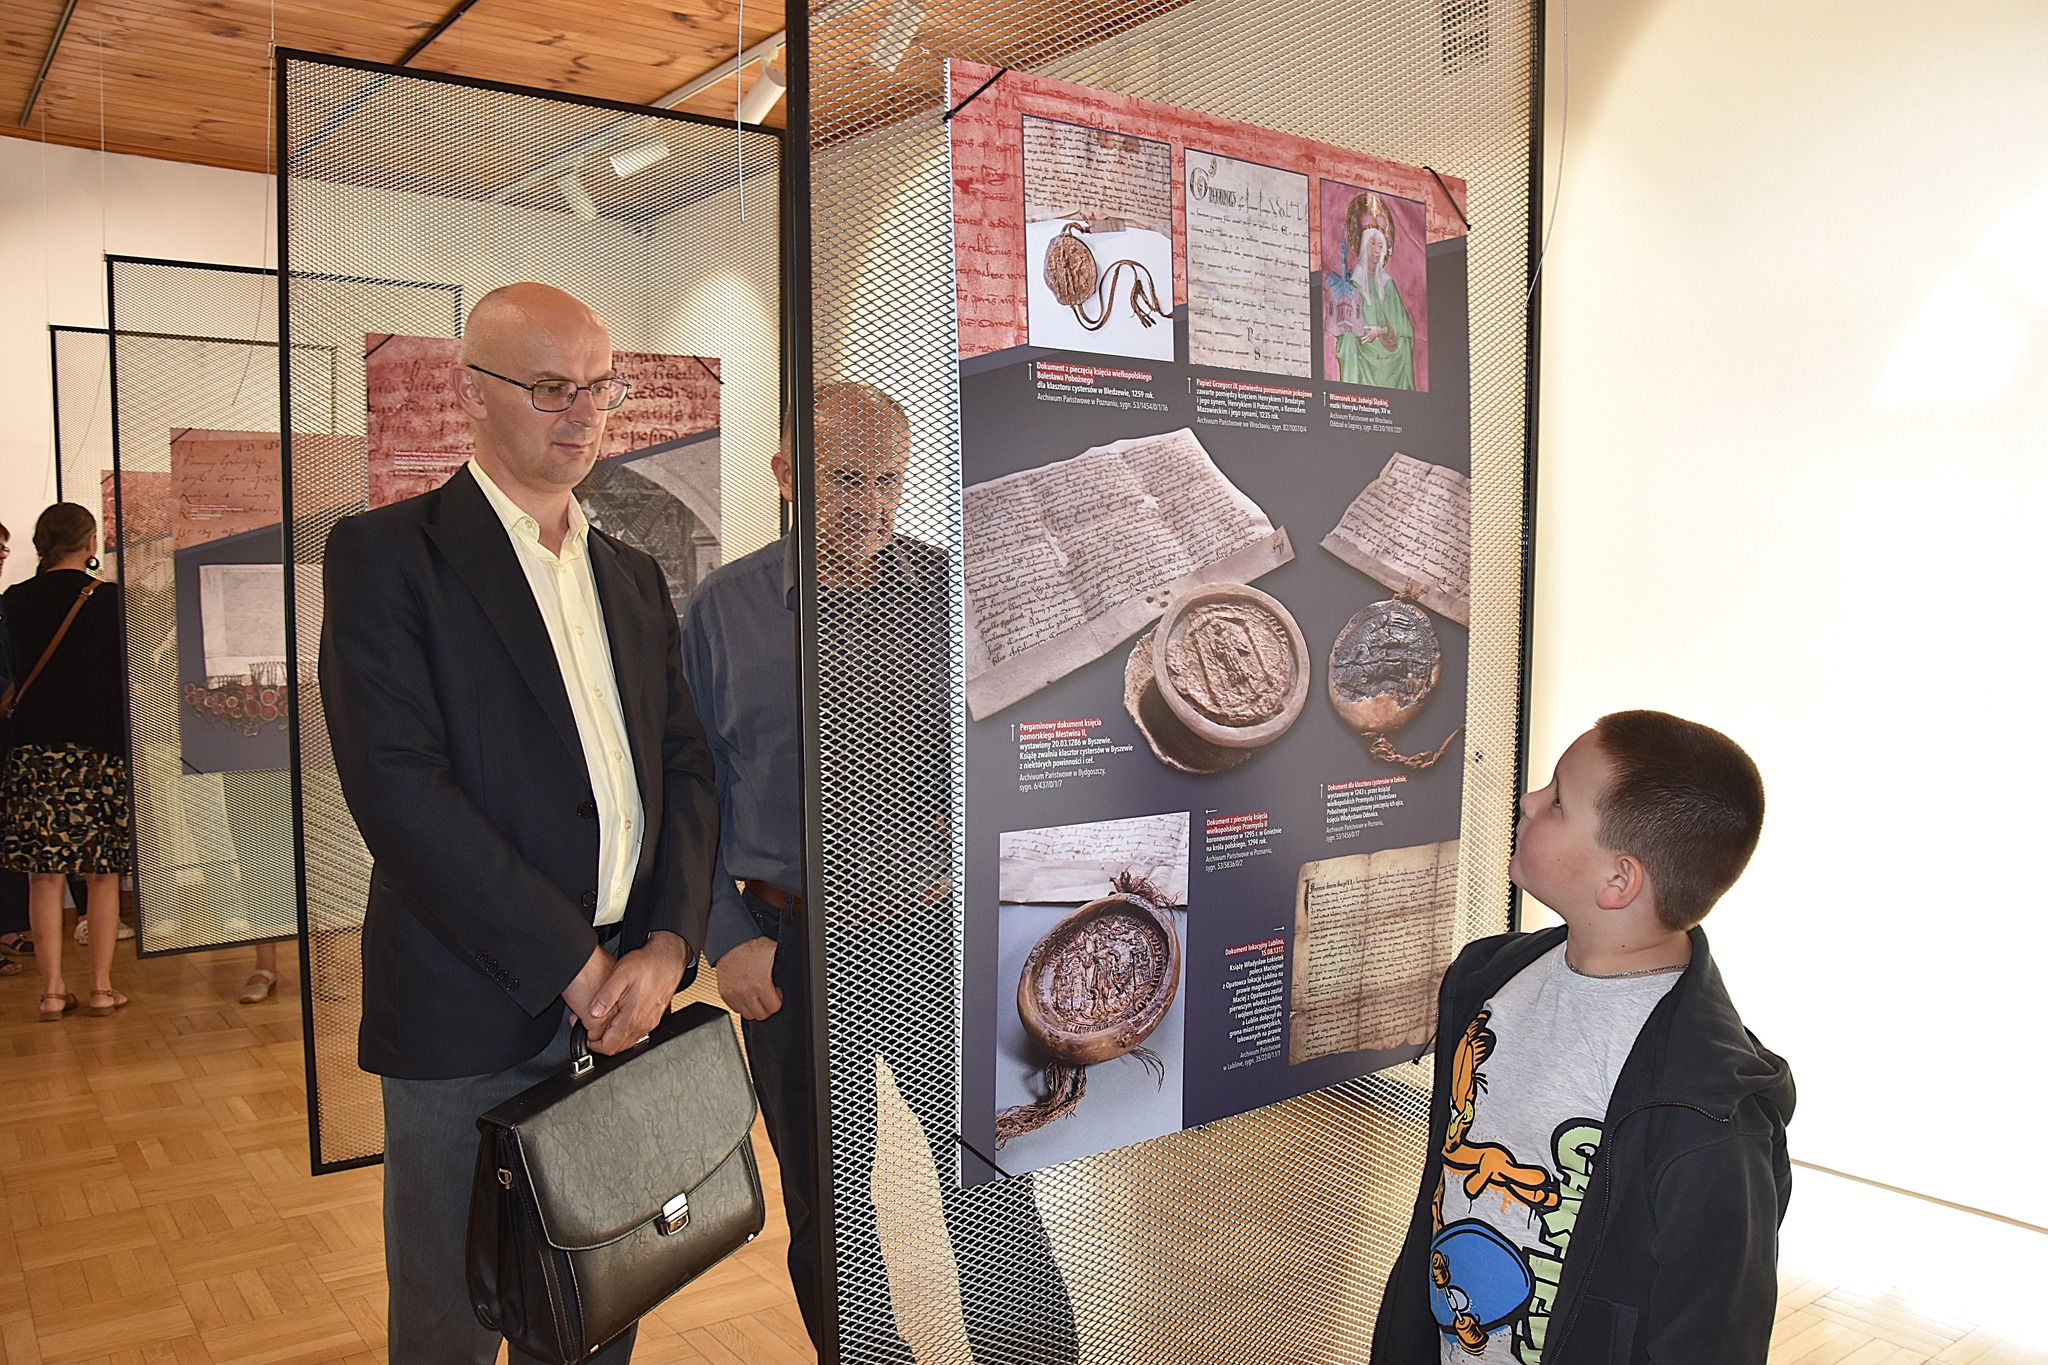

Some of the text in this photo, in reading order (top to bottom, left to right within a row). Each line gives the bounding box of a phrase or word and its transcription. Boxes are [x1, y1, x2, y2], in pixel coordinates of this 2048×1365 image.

[1036, 362, 1064, 372] Dokument
[1070, 365, 1093, 377] pieczęcią
[1094, 367, 1111, 378] księcia
[1111, 370, 1152, 382] wielkopolskiego
[1037, 372, 1094, 386] Bolesława Pobożnego
[1037, 381, 1046, 389] dla
[1046, 382, 1071, 391] klasztoru
[1072, 385, 1097, 394] cystersów
[1131, 389, 1144, 398] 1259
[1196, 379, 1211, 388] Papież
[1212, 380, 1232, 390] Grzegorz
[1238, 384, 1262, 392] potwierdza
[1292, 390, 1313, 399] pokojowe
[1037, 393, 1062, 402] Archiwum
[1063, 395, 1090, 404] Państwowe
[1120, 402, 1132, 410] sygn.
[1199, 397, 1210, 405] jego
[1227, 399, 1252, 409] Henrykiem
[1284, 405, 1306, 413] Konradem
[1215, 390, 1237, 400] pomiędzy
[1238, 392, 1257, 401] księciem
[1258, 394, 1281, 403] Henrykiem
[1285, 397, 1305, 407] Brodatym
[1197, 405, 1228, 414] Mazowieckim
[1230, 409, 1241, 417] jego
[1020, 718, 1102, 732] Pergaminowy dokument księcia
[1020, 730, 1081, 743] pomorskiego Mestwina
[1020, 742, 1051, 752] wystawiony
[1052, 739, 1081, 748] 20.03.1286
[1020, 752, 1037, 761] Książę
[1038, 750, 1058, 758] zwalnia
[1058, 749, 1079, 757] klasztor
[1079, 747, 1104, 757] cystersów
[1111, 744, 1134, 754] Byszewie
[1024, 760, 1052, 769] niektórych
[1052, 758, 1082, 769] powinności
[1020, 773, 1044, 781] Archiwum
[1045, 771, 1073, 779] Państwowe
[1206, 813, 1268, 826] Dokument pieczęcią księcia
[1206, 825, 1242, 835] wielkopolskiego
[1242, 821, 1264, 830] Przemysła
